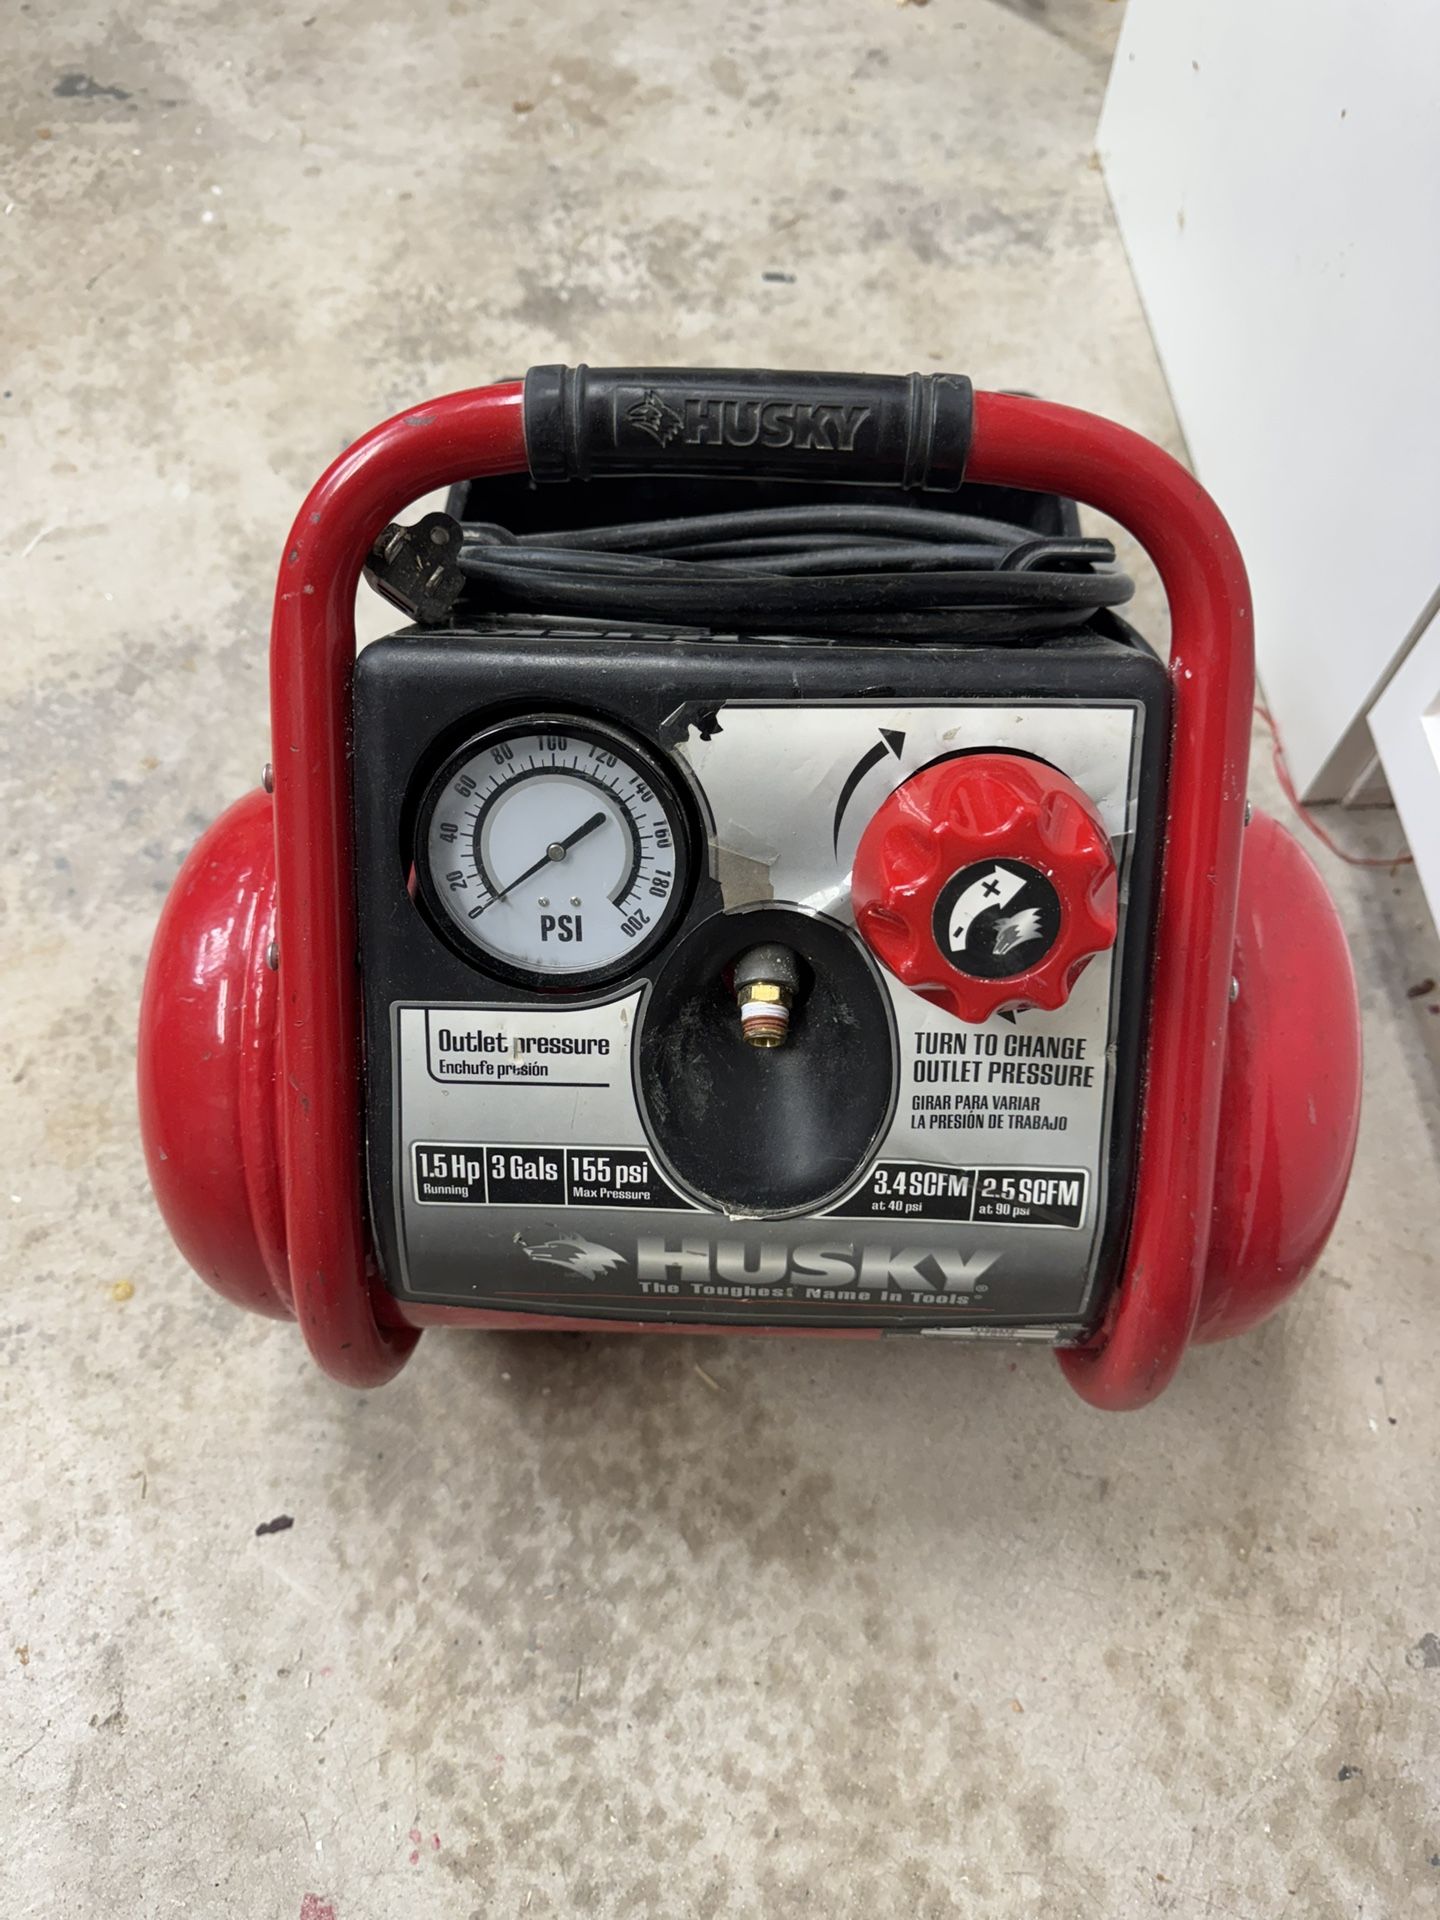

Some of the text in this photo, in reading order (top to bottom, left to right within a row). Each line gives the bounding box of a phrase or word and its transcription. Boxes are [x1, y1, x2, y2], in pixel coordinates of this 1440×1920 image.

[685, 399, 870, 451] HUSKY
[490, 743, 514, 765] 80
[537, 735, 567, 751] 100
[588, 744, 618, 768] 120
[455, 774, 477, 798] 60
[629, 776, 654, 803] 140
[440, 822, 458, 843] 40
[653, 819, 672, 849] 160
[446, 870, 468, 891] 20
[649, 869, 671, 898] 180
[541, 914, 583, 942] PSI
[621, 908, 650, 938] 200
[438, 1029, 610, 1059] Outlet pressure
[914, 1032, 1087, 1060] TURN TO CHANGE
[439, 1060, 549, 1079] Enchufe presión
[913, 1060, 1094, 1088] OUTLET PRESSURE
[912, 1095, 1040, 1111] GIRAR PARA VARIAR
[911, 1110, 1068, 1131] LA PRESIÓN DE TRABAJO
[419, 1153, 480, 1185] 1.5 Hp
[491, 1155, 558, 1181] 3 Gals
[571, 1157, 648, 1188] 155 psi
[424, 1183, 469, 1197] Running
[573, 1187, 650, 1200] Max Pressure
[874, 1170, 969, 1197] 3.4 SCFM
[981, 1177, 1079, 1206] 2.5 SCFM
[872, 1201, 922, 1213] at 40 psi
[979, 1204, 1030, 1217] at 90 psi
[639, 1281, 679, 1293] The
[690, 1283, 793, 1297] Toughest
[805, 1287, 871, 1300] Name
[881, 1291, 902, 1302] In
